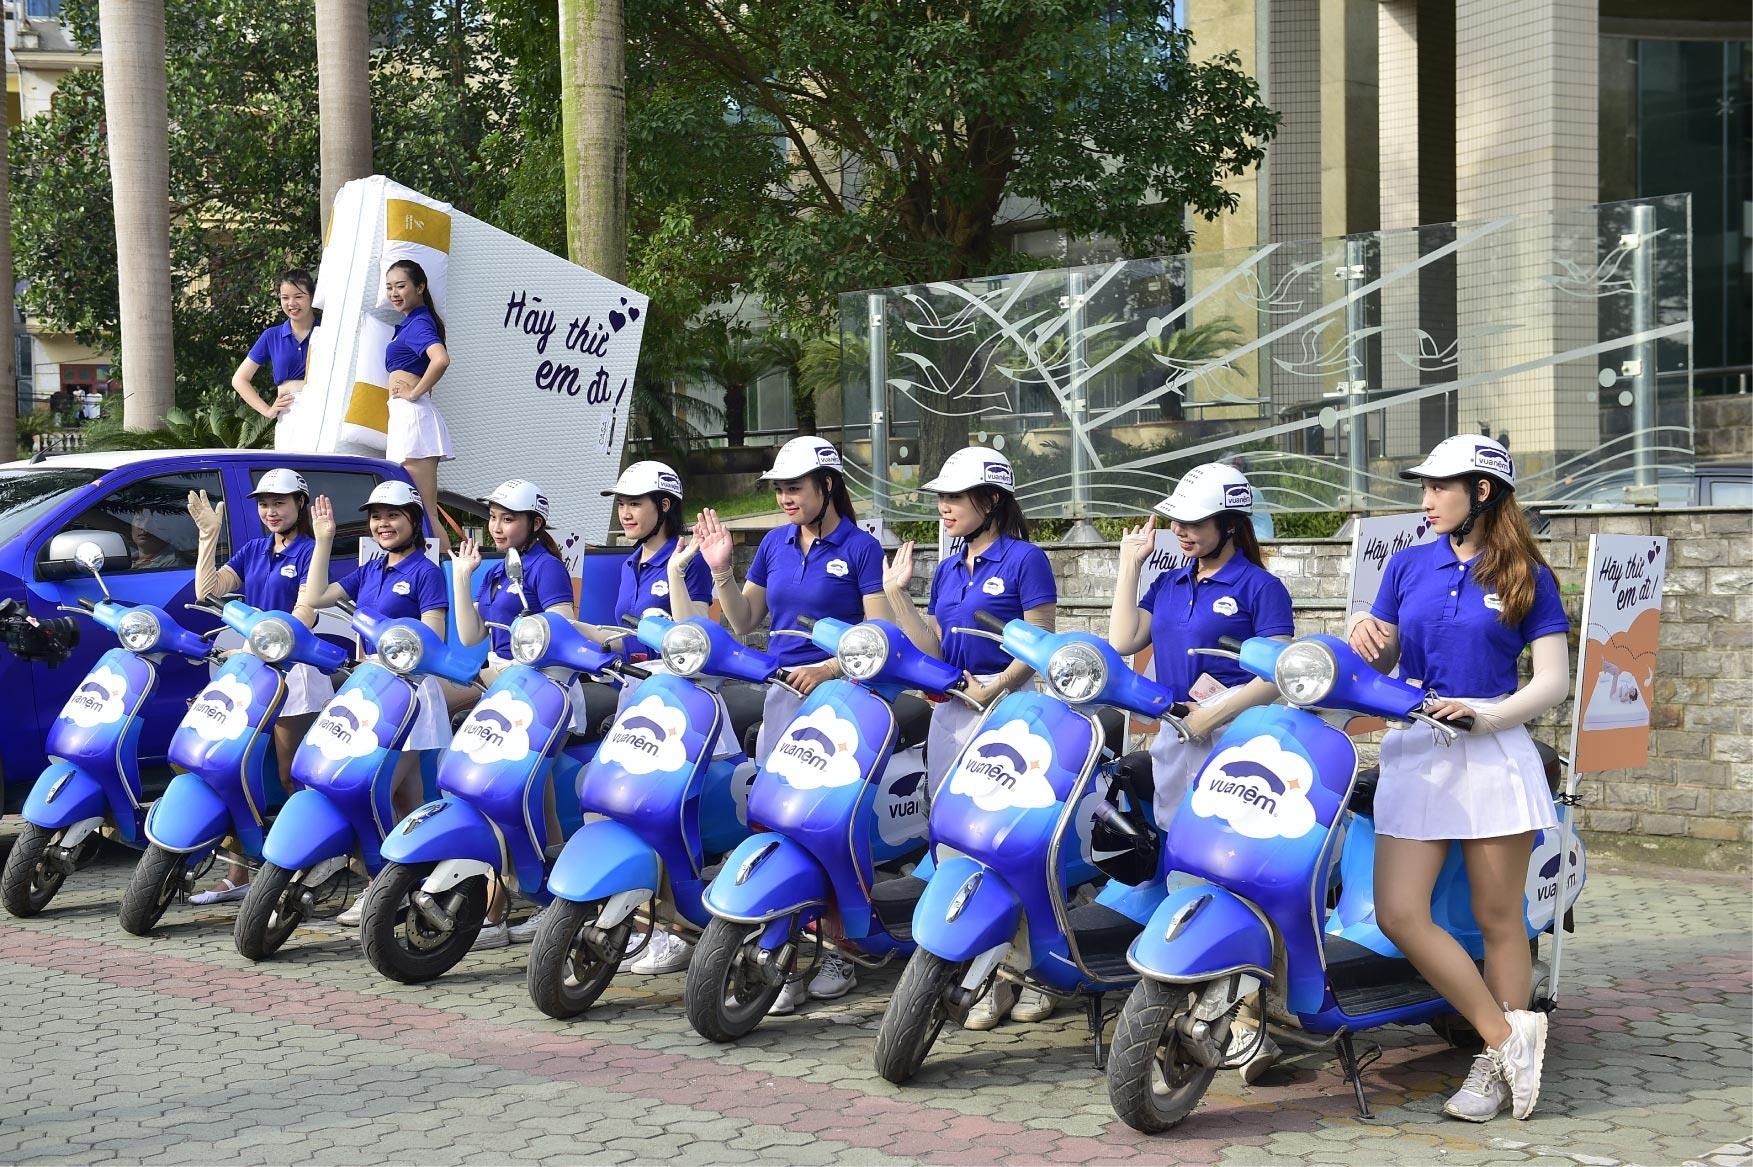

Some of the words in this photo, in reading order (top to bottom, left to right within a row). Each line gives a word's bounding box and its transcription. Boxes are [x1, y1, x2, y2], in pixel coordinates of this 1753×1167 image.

[504, 290, 556, 354] Hãy
[536, 360, 581, 396] em
[1616, 586, 1637, 611] em
